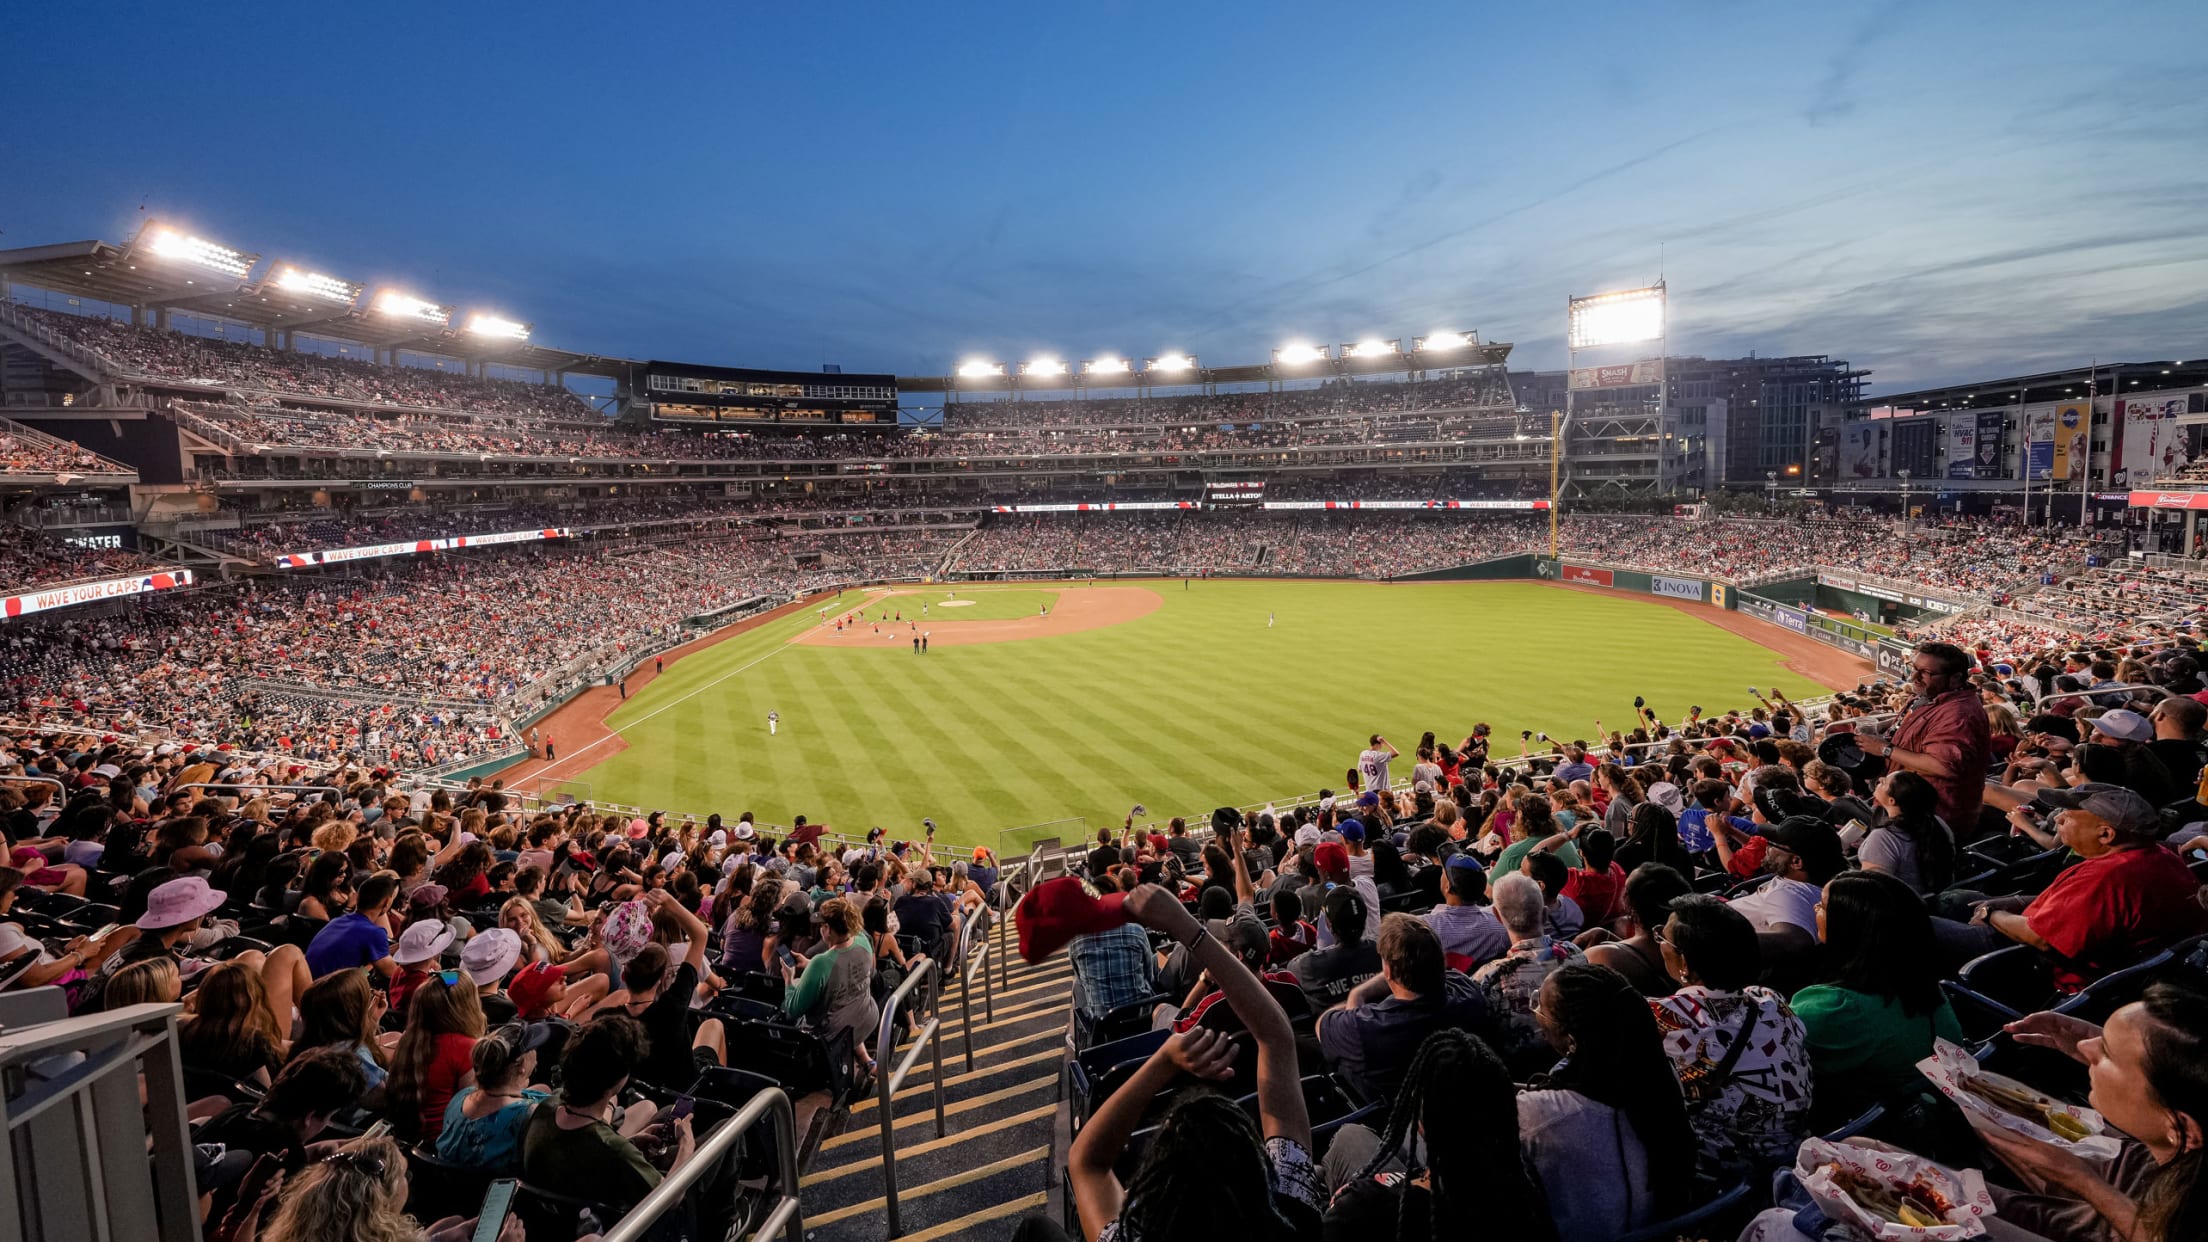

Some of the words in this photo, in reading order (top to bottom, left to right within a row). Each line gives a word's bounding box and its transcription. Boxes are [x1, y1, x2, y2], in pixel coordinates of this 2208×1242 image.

[1601, 367, 1628, 378] SMASH
[329, 551, 354, 561] WAVE
[358, 547, 379, 556] YOUR
[382, 544, 405, 554] CAPS
[36, 591, 69, 609] WAVE
[73, 586, 103, 601] YOUR
[107, 580, 139, 596] CAPS
[1664, 581, 1700, 596] INOVA
[1784, 613, 1804, 630] Terra
[1364, 763, 1378, 777] 48
[1327, 977, 1350, 996] WE
